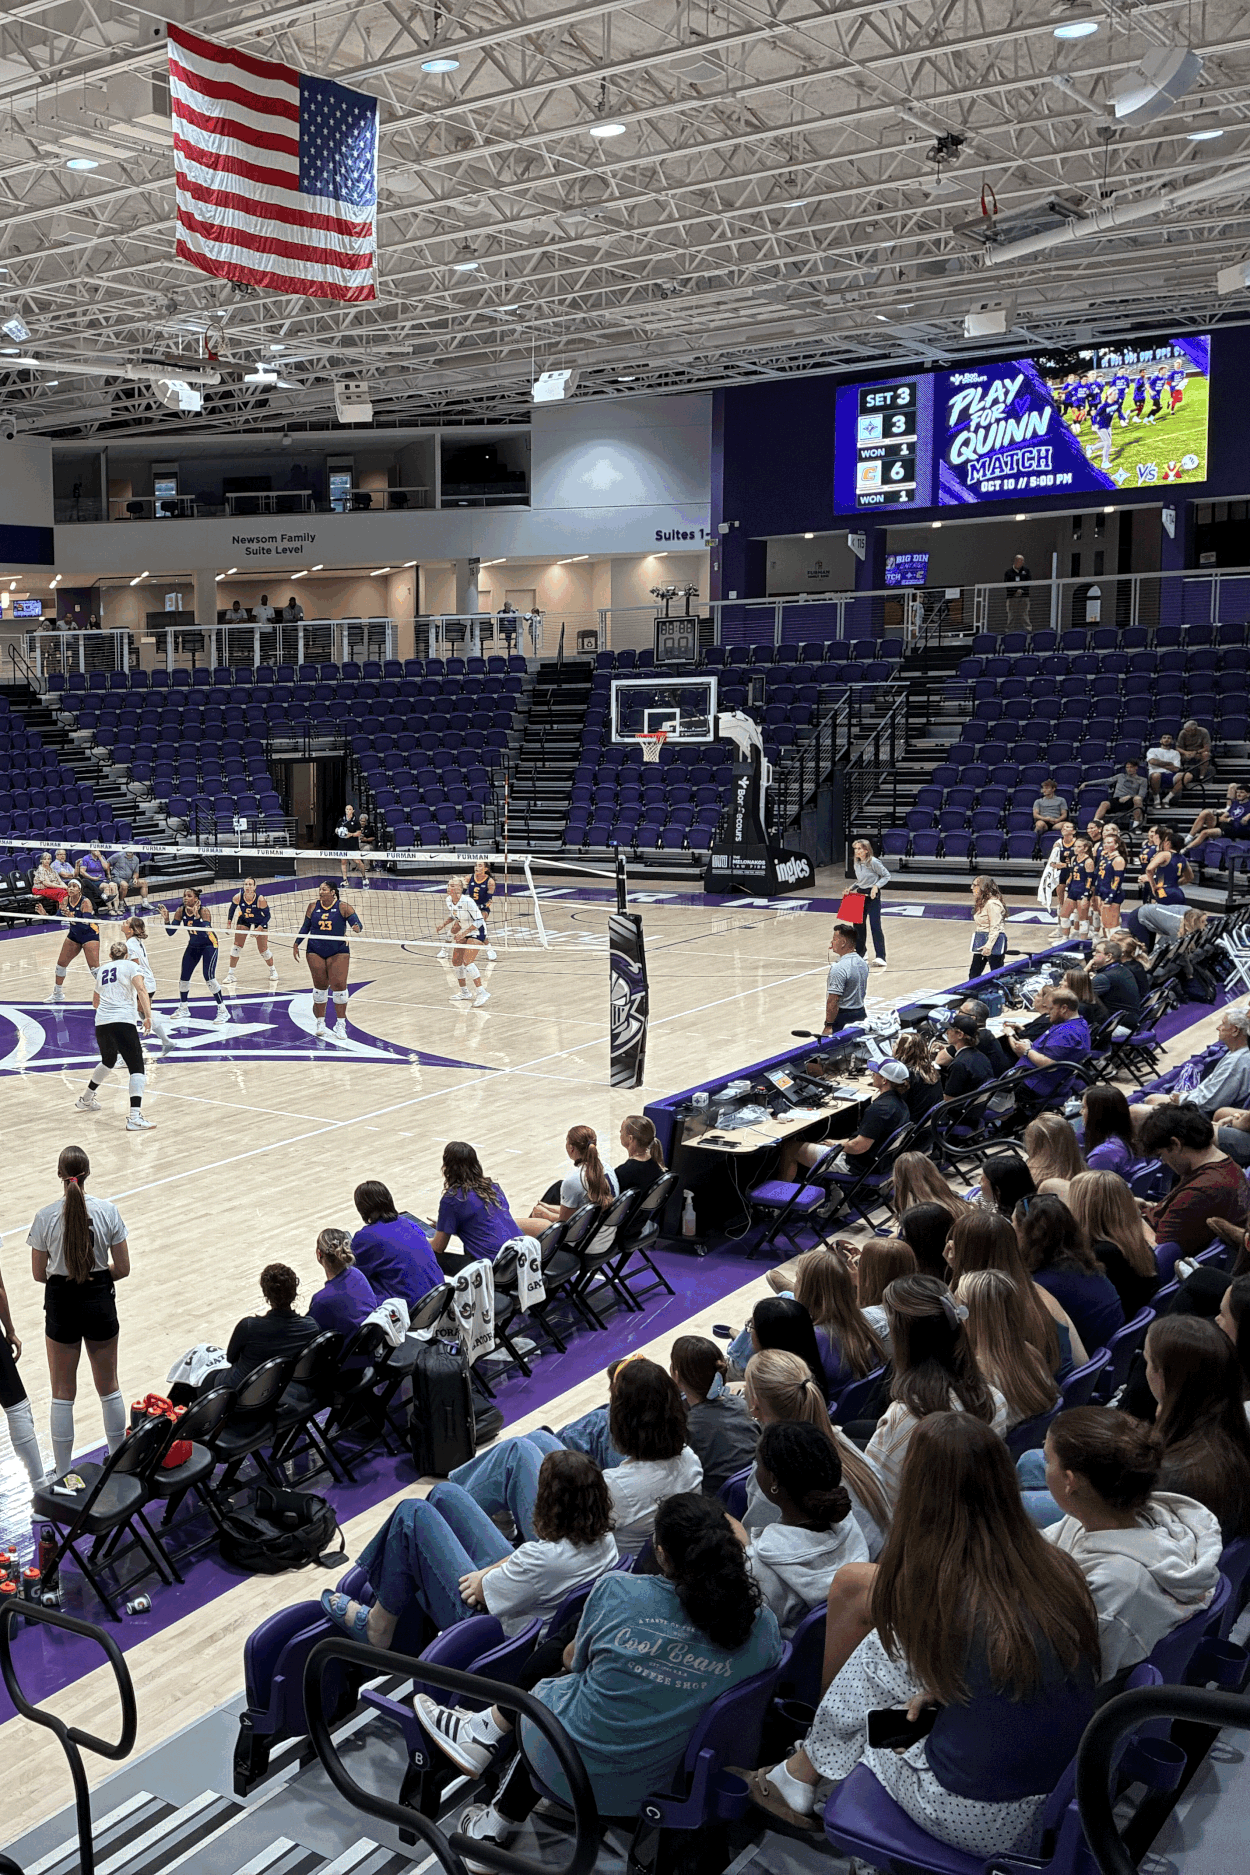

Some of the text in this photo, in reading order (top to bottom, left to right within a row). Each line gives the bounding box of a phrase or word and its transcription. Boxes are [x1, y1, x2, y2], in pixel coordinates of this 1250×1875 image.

[866, 387, 910, 407] SET 3
[949, 374, 1024, 427] PLAY
[891, 415, 906, 433] 3
[970, 403, 1007, 432] FOR
[950, 406, 1051, 464] QUINN
[861, 444, 909, 458] WON 1
[890, 461, 905, 480] 6
[967, 446, 1052, 485] MATCH
[981, 480, 1001, 492] OCT
[1003, 479, 1015, 490] 10
[1030, 475, 1053, 487] 5:00
[1056, 473, 1073, 485] PM
[860, 491, 908, 504] WON 1
[232, 533, 316, 544] Newsom Family
[655, 529, 695, 542] Suites
[245, 545, 303, 556] Suite Level
[774, 856, 810, 883] ingles
[318, 920, 332, 931] 23
[101, 967, 118, 985] 23
[614, 1628, 734, 1678] Cool Beans
[628, 1661, 708, 1690] COFFEE SHOP
[415, 1752, 424, 1765] B
[646, 1806, 661, 1819] C
